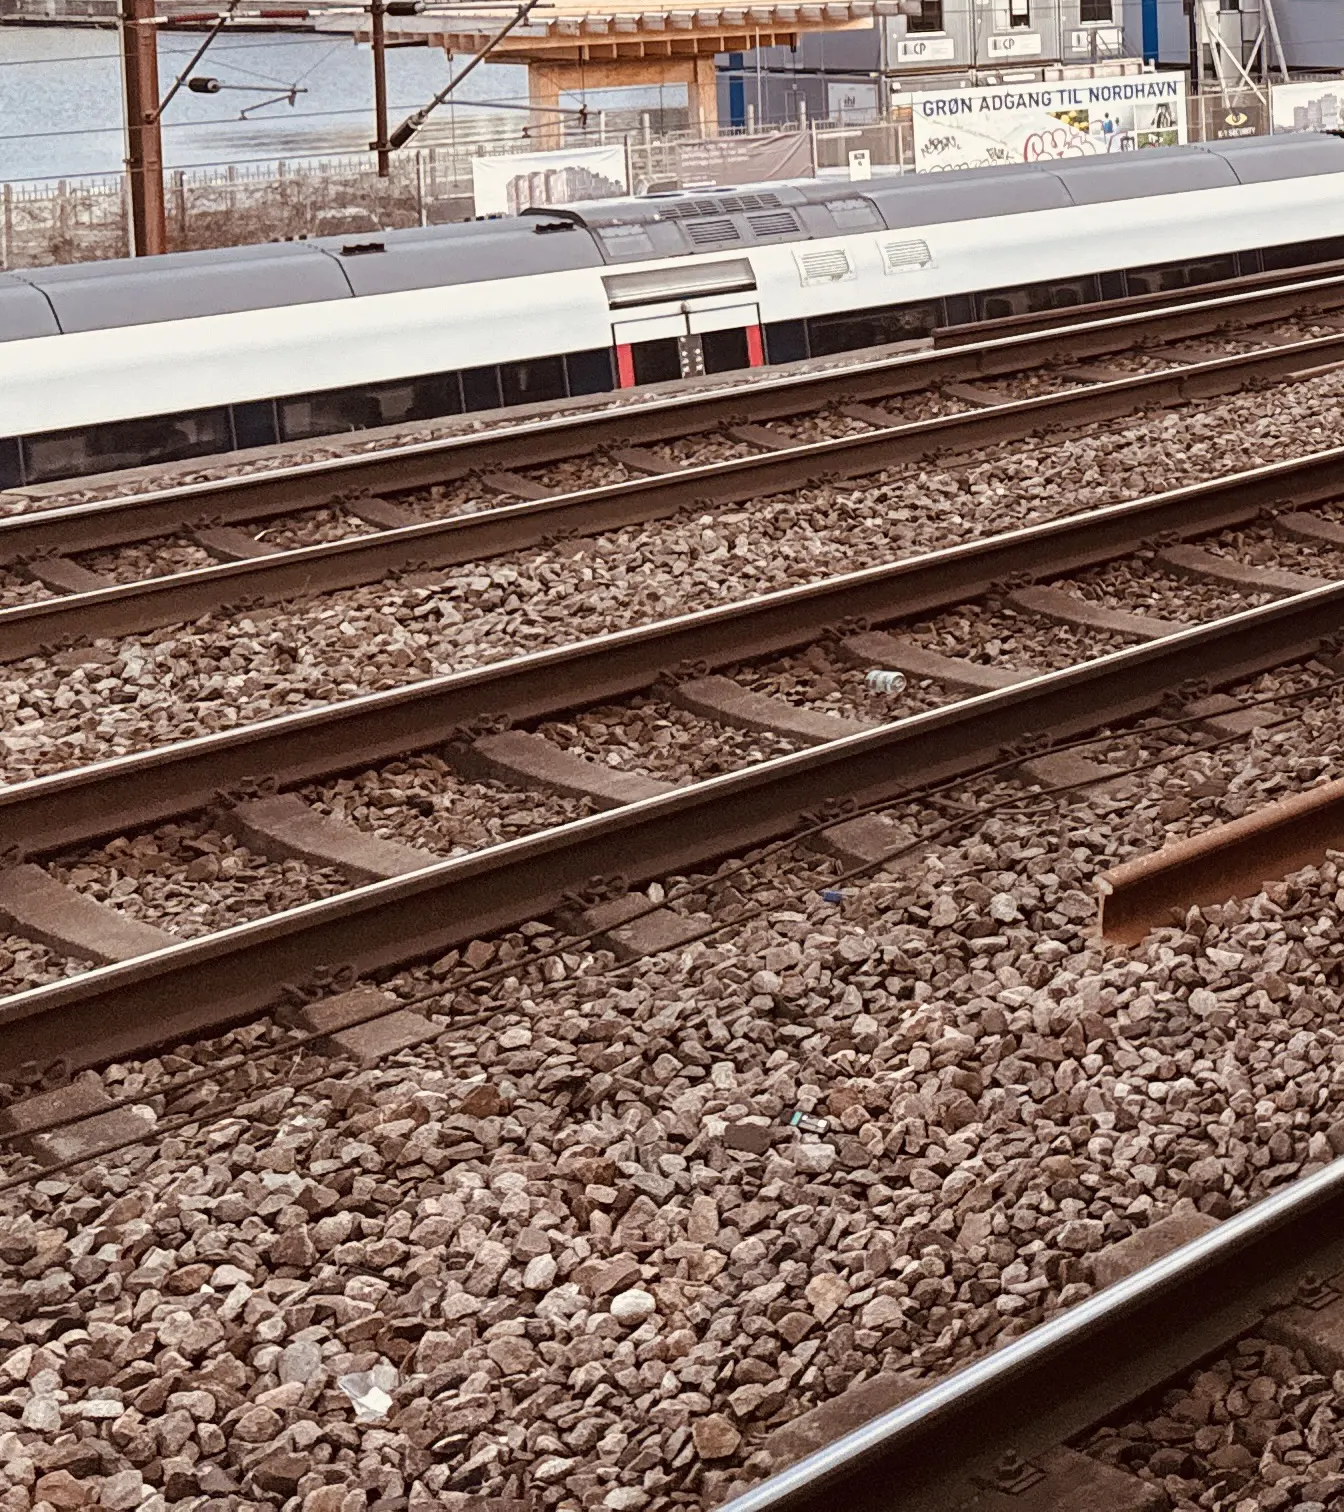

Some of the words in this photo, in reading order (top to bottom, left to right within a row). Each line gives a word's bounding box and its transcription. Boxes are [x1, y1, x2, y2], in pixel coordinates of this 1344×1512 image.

[923, 97, 973, 117] GRØN
[979, 92, 1052, 113] ADGANG
[1059, 89, 1083, 106] TIL
[1089, 81, 1178, 104] NORDHAVN
